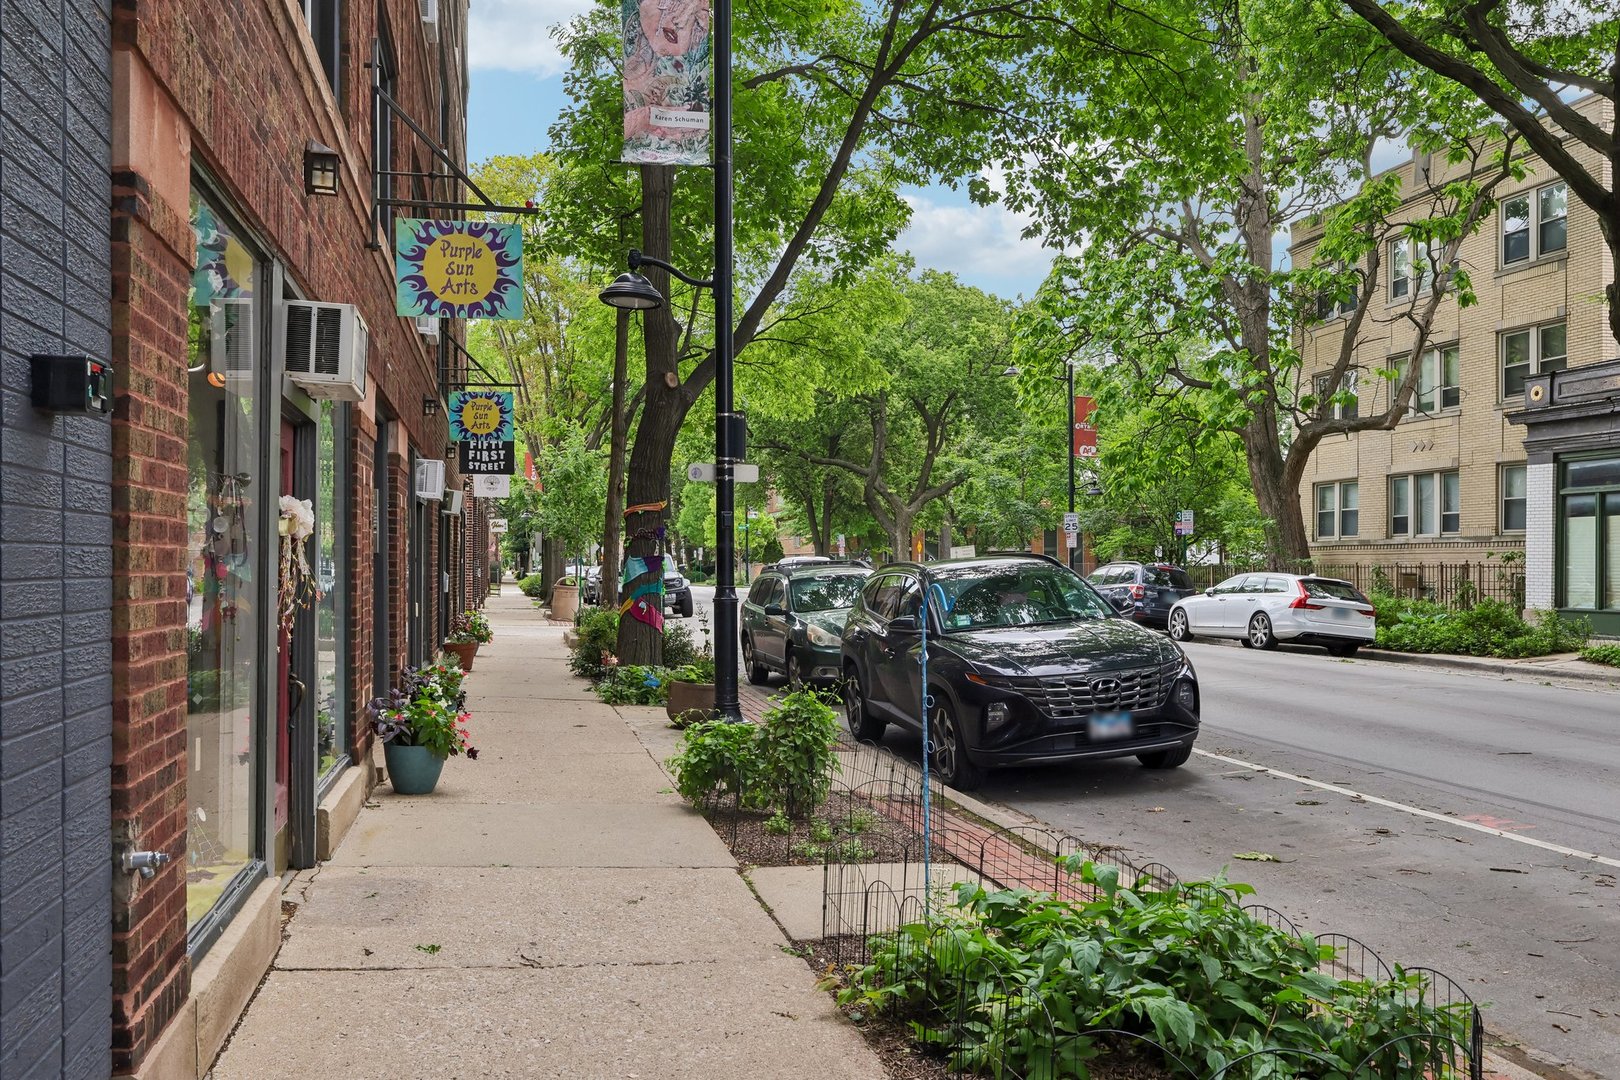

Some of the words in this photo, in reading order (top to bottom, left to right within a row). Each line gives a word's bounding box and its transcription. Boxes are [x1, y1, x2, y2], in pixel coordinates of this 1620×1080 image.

[654, 114, 673, 122] Karen
[440, 240, 483, 261] Purple
[445, 261, 474, 276] Sun
[440, 277, 479, 295] Arts
[471, 402, 493, 413] Purple
[473, 412, 489, 420] Sun
[470, 421, 491, 430] Arts
[469, 440, 504, 449] FIFTY
[468, 450, 507, 462] FIRST
[468, 461, 507, 471] STREET
[1065, 522, 1078, 531] 25
